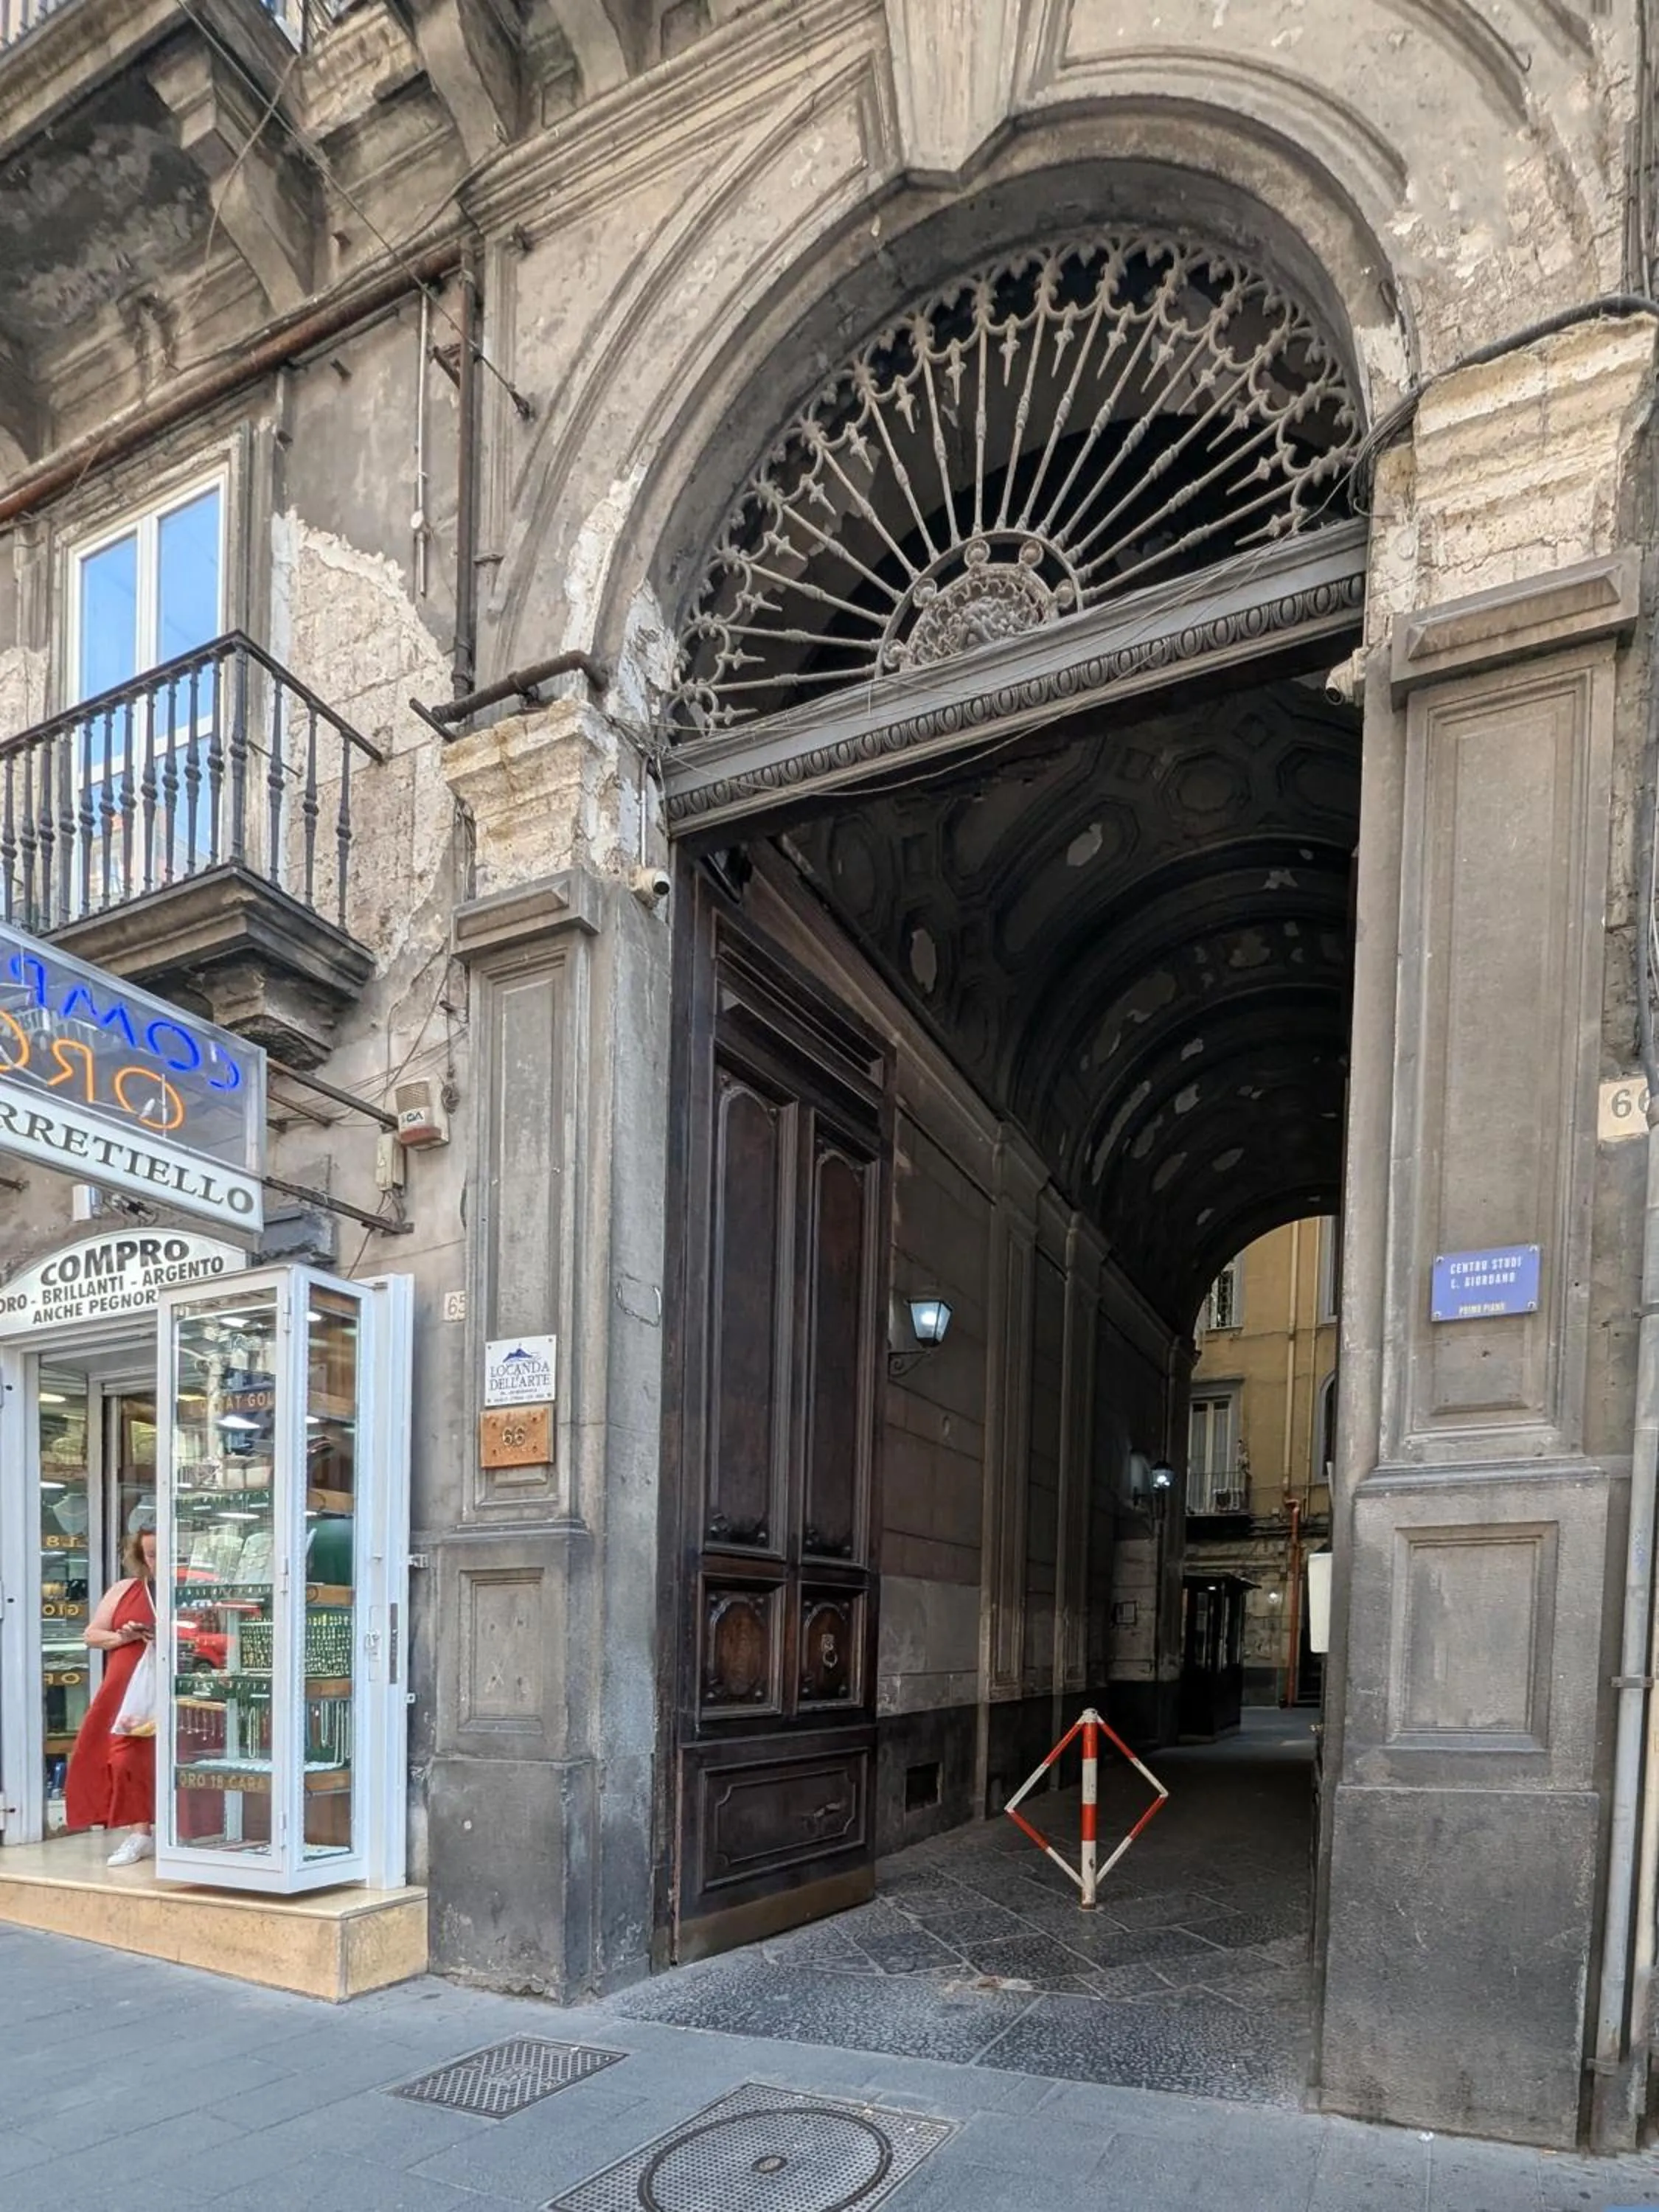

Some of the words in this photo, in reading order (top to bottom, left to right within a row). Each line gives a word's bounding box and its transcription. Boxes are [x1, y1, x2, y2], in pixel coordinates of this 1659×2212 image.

[40, 1239, 189, 1287] COMPRO
[1450, 1260, 1487, 1275] CENTRO
[1492, 1256, 1522, 1270] STUDI
[41, 1275, 124, 1306] BRILLANTI
[142, 1255, 224, 1287] ARGENTO
[1464, 1273, 1516, 1287] GIORDANO
[32, 1304, 83, 1325] ANCHE
[490, 1361, 549, 1377] LOCANDA
[502, 1426, 526, 1446] 66
